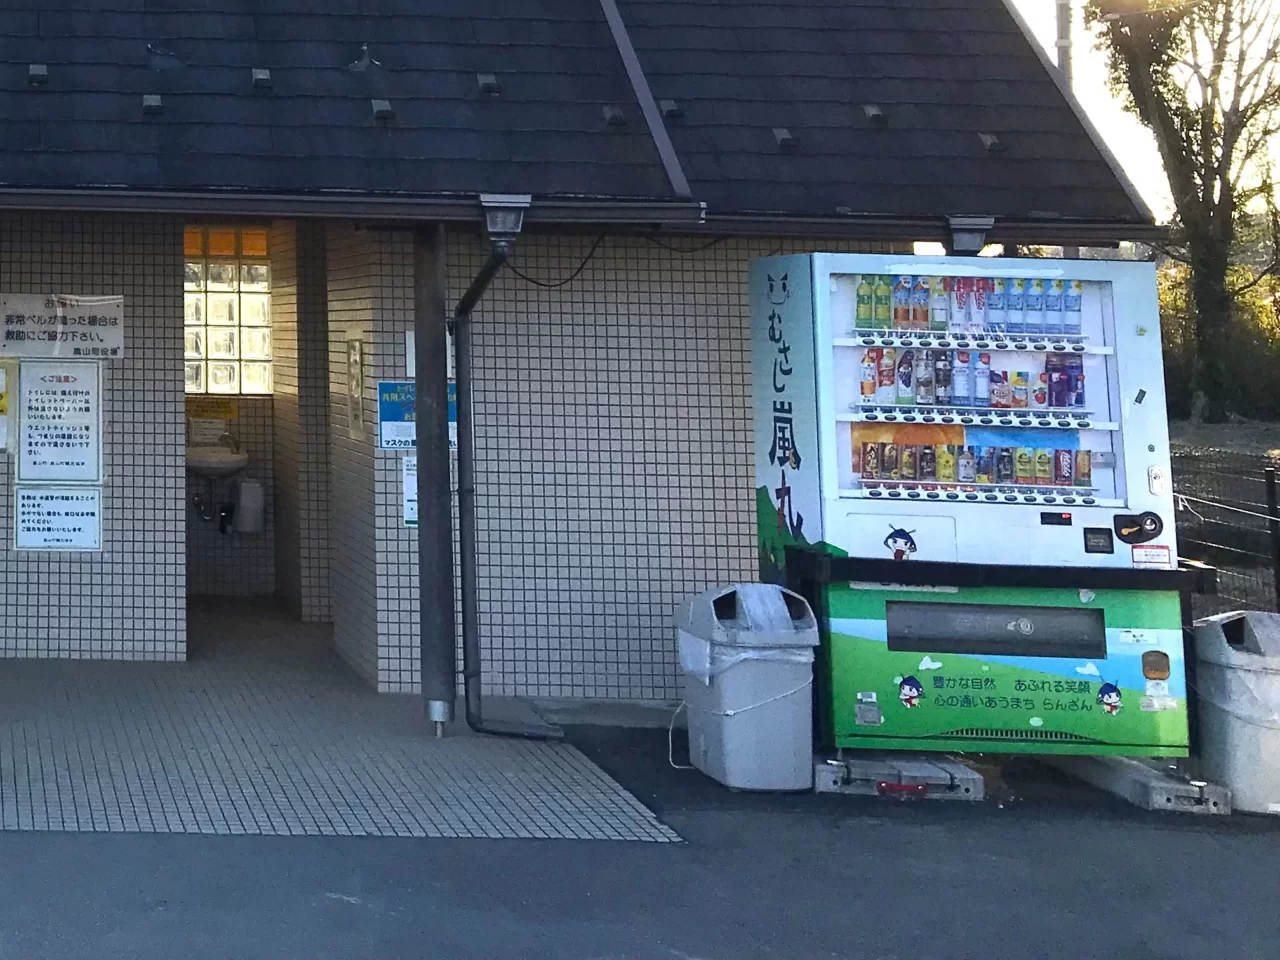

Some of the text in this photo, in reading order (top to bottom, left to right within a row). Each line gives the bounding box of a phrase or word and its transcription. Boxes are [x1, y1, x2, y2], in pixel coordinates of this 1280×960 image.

[933, 676, 1091, 694] 豊かな自然 あふれる笑顔
[934, 695, 1093, 711] 心の通いあうまち らんざん
